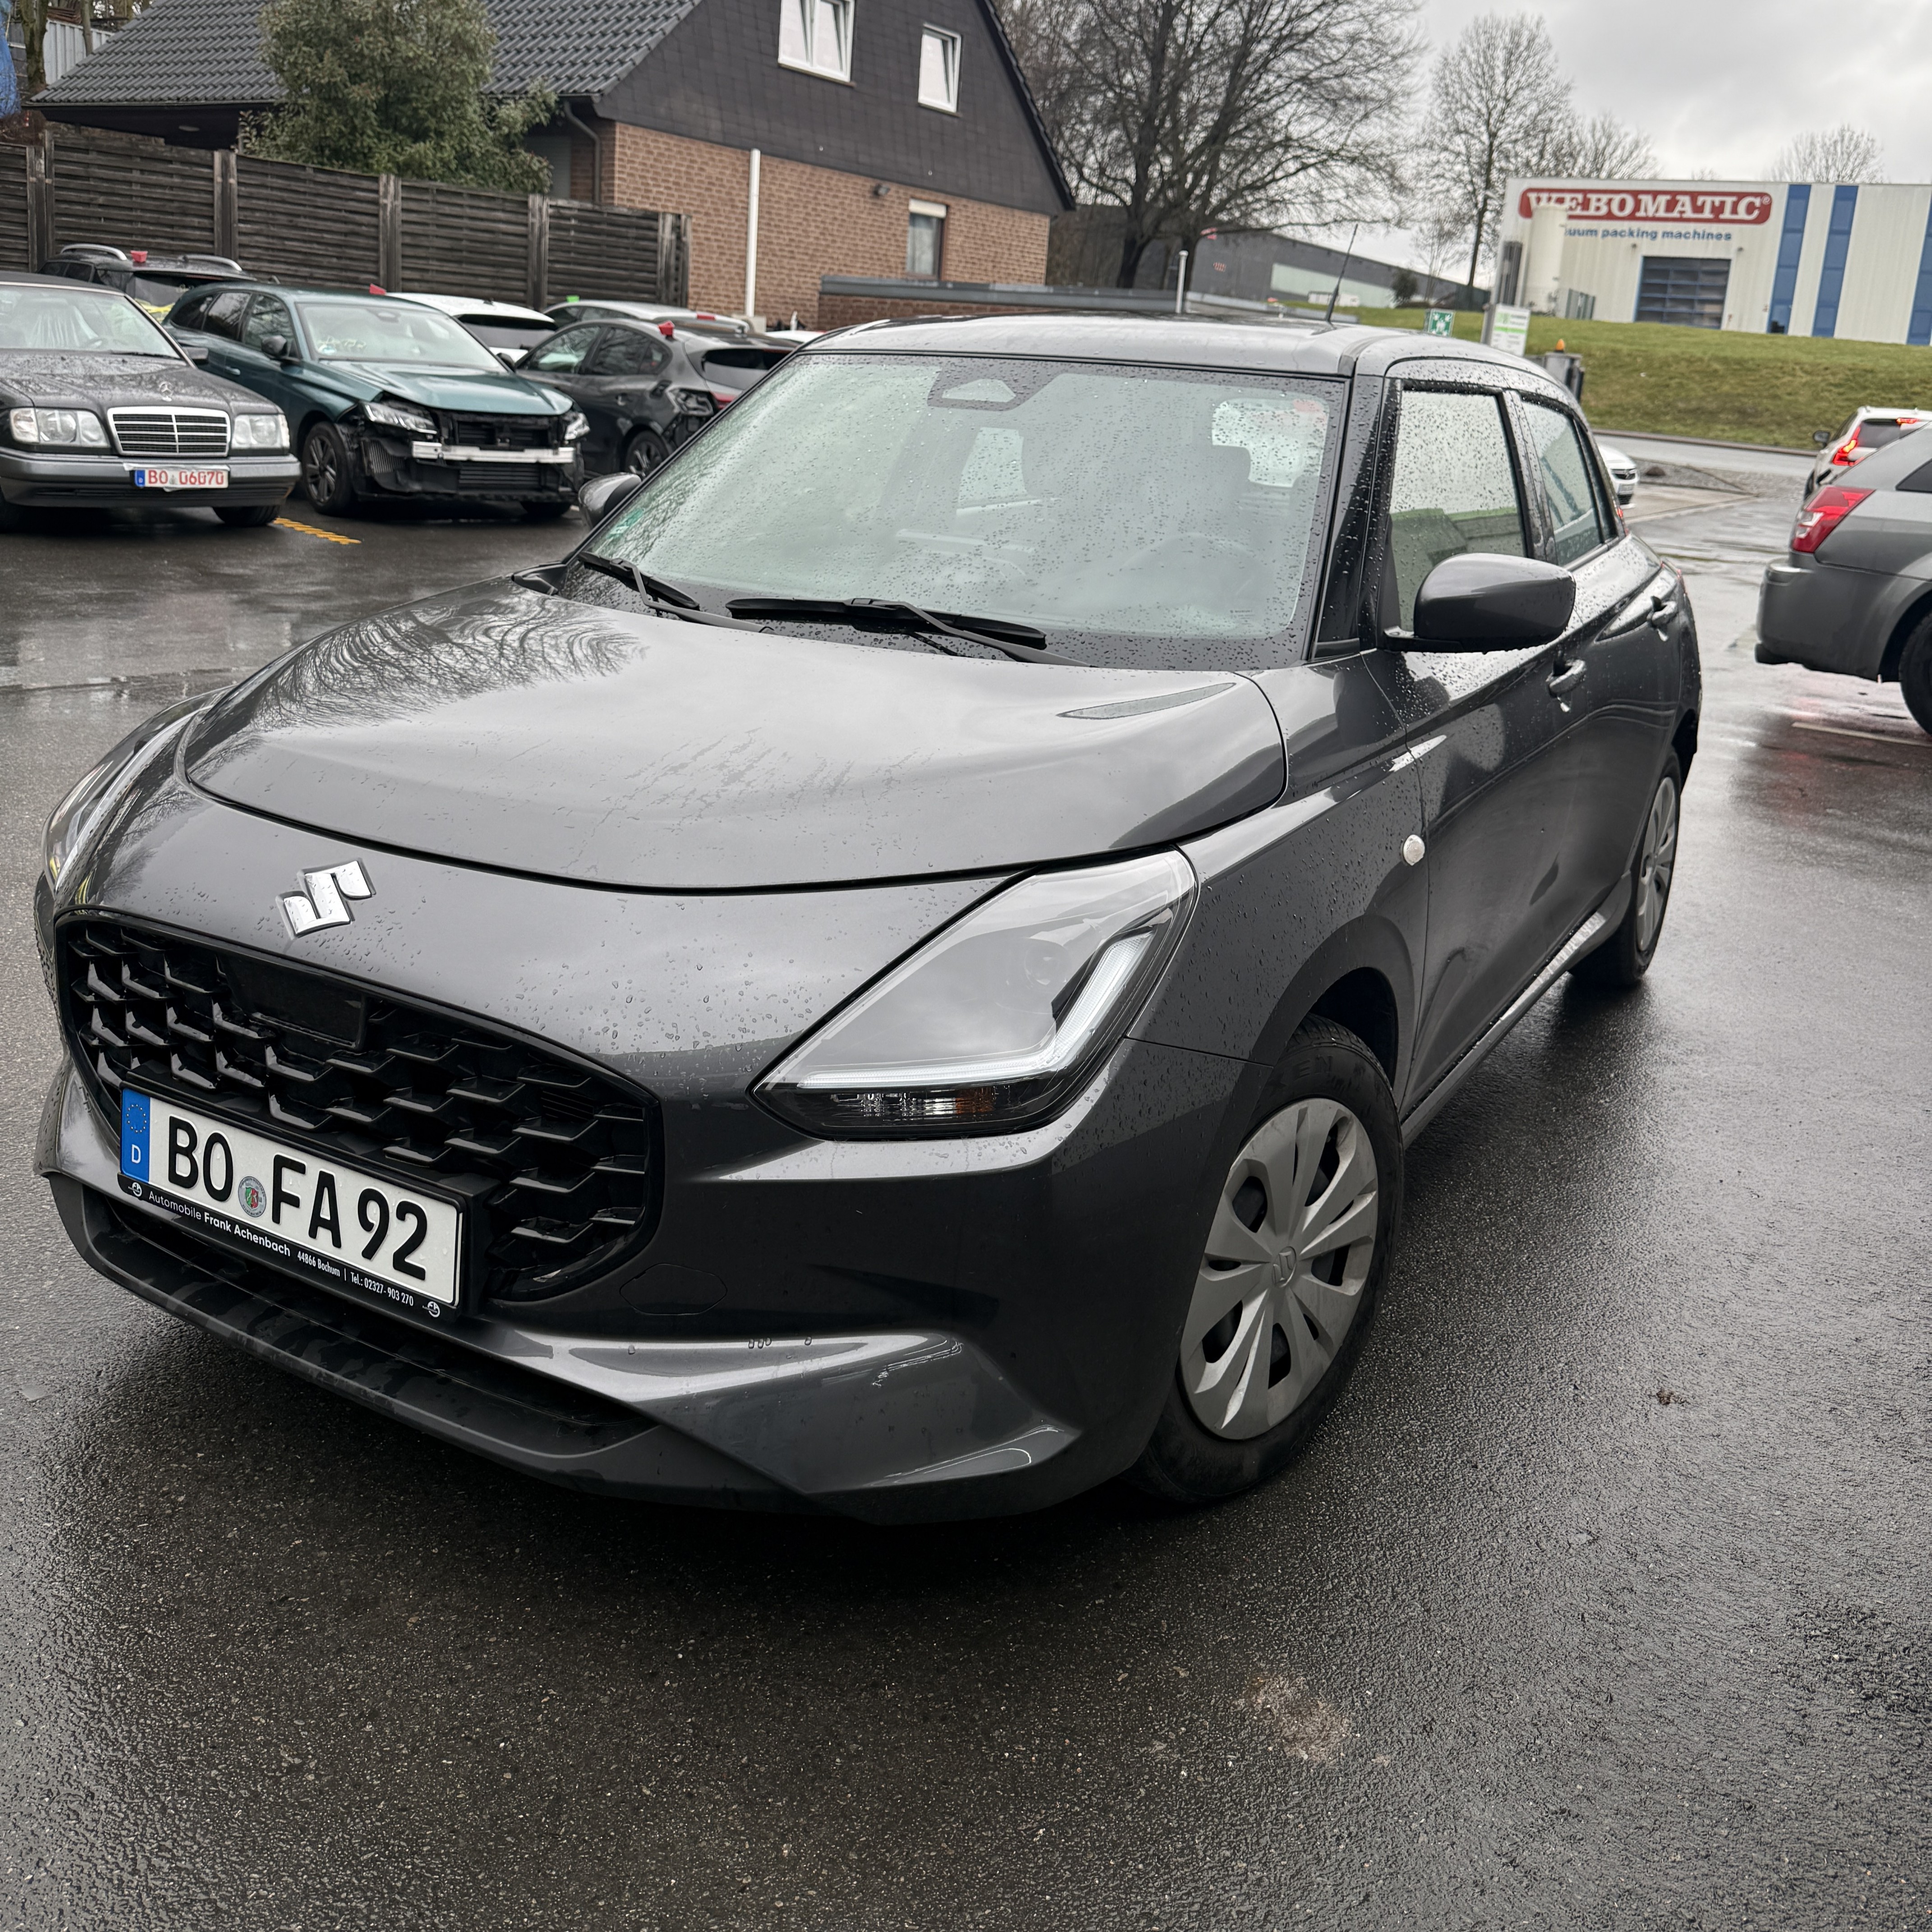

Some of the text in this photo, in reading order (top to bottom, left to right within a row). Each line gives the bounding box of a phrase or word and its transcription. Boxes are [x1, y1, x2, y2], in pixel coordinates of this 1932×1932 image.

[1601, 227, 1658, 240] packing
[1661, 229, 1732, 241] machines
[148, 470, 168, 484] BO
[132, 1115, 428, 1281] D BO FA 92
[149, 1191, 202, 1220] Automobile
[204, 1212, 232, 1233] Frank
[234, 1224, 290, 1257] Achenbach
[297, 1250, 316, 1267] 44866
[317, 1258, 340, 1277] Bochum
[350, 1272, 363, 1286] Tel.:
[401, 1292, 414, 1306] 270
